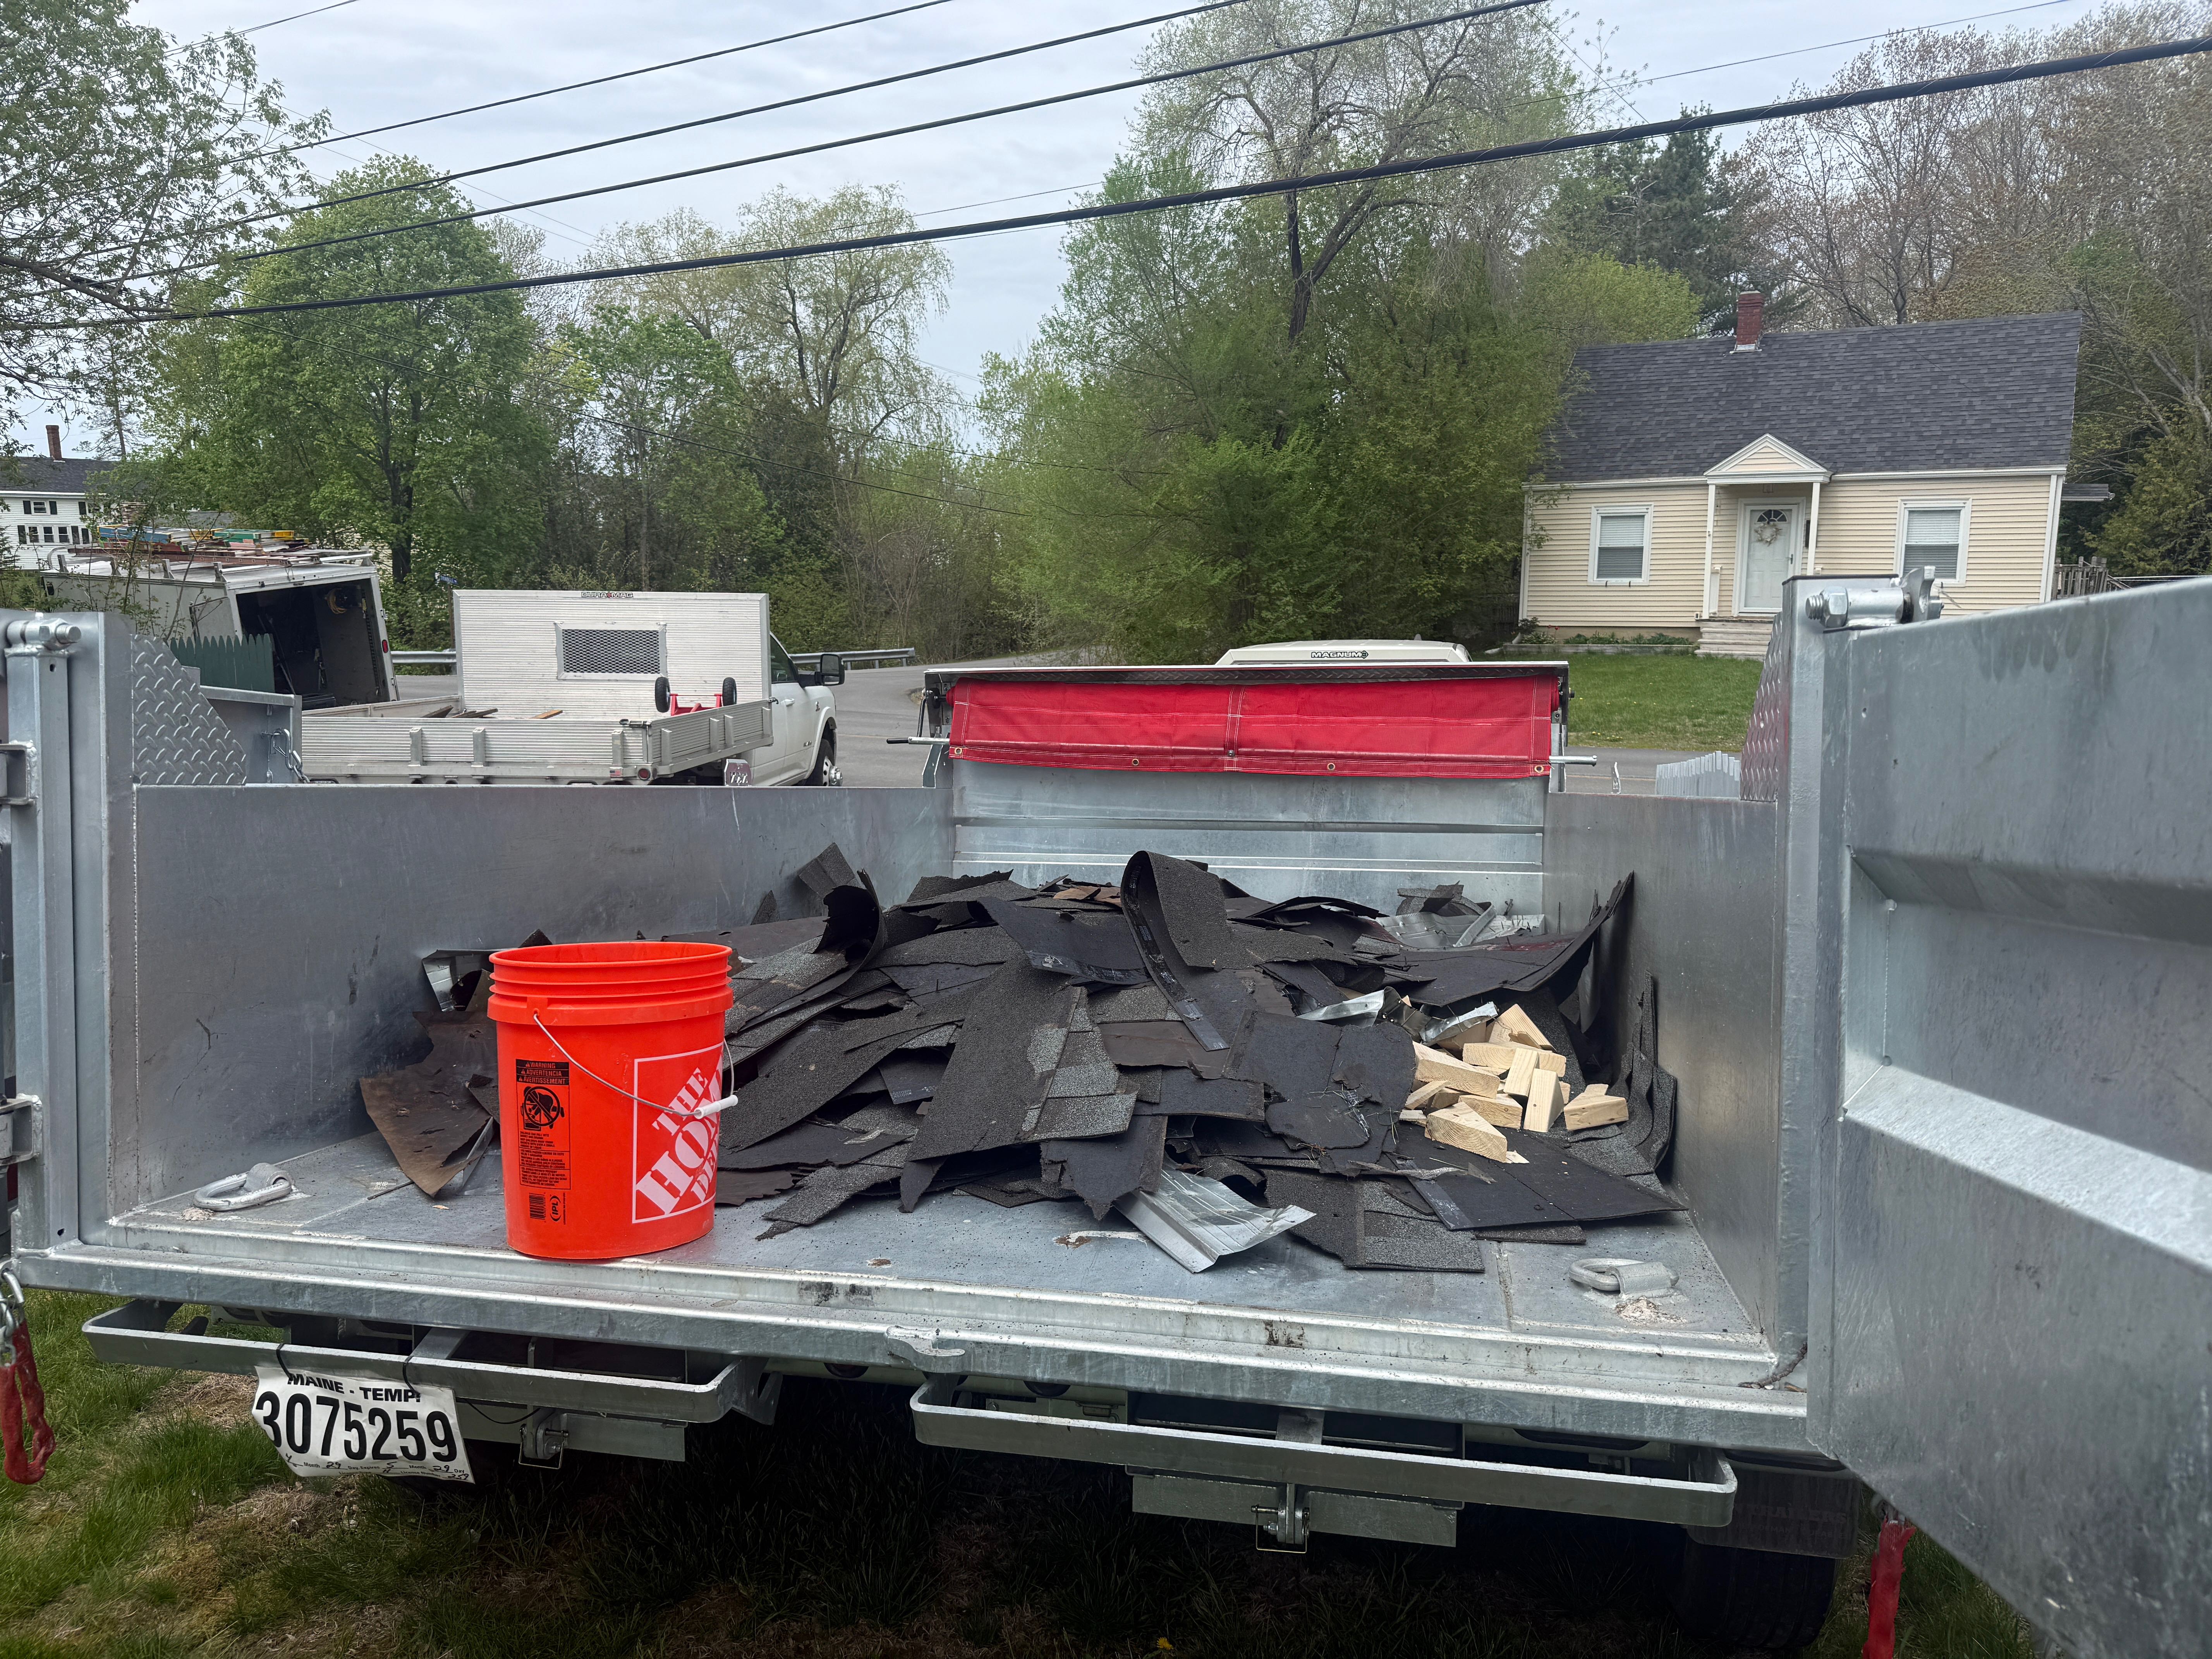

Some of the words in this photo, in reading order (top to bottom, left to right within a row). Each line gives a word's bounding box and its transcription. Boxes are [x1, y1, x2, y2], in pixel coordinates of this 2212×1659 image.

[523, 1076, 565, 1085] AVERTISSEMENT
[652, 1067, 708, 1137] THE
[287, 1374, 345, 1394] MAINE
[256, 1391, 457, 1462] 3075259
